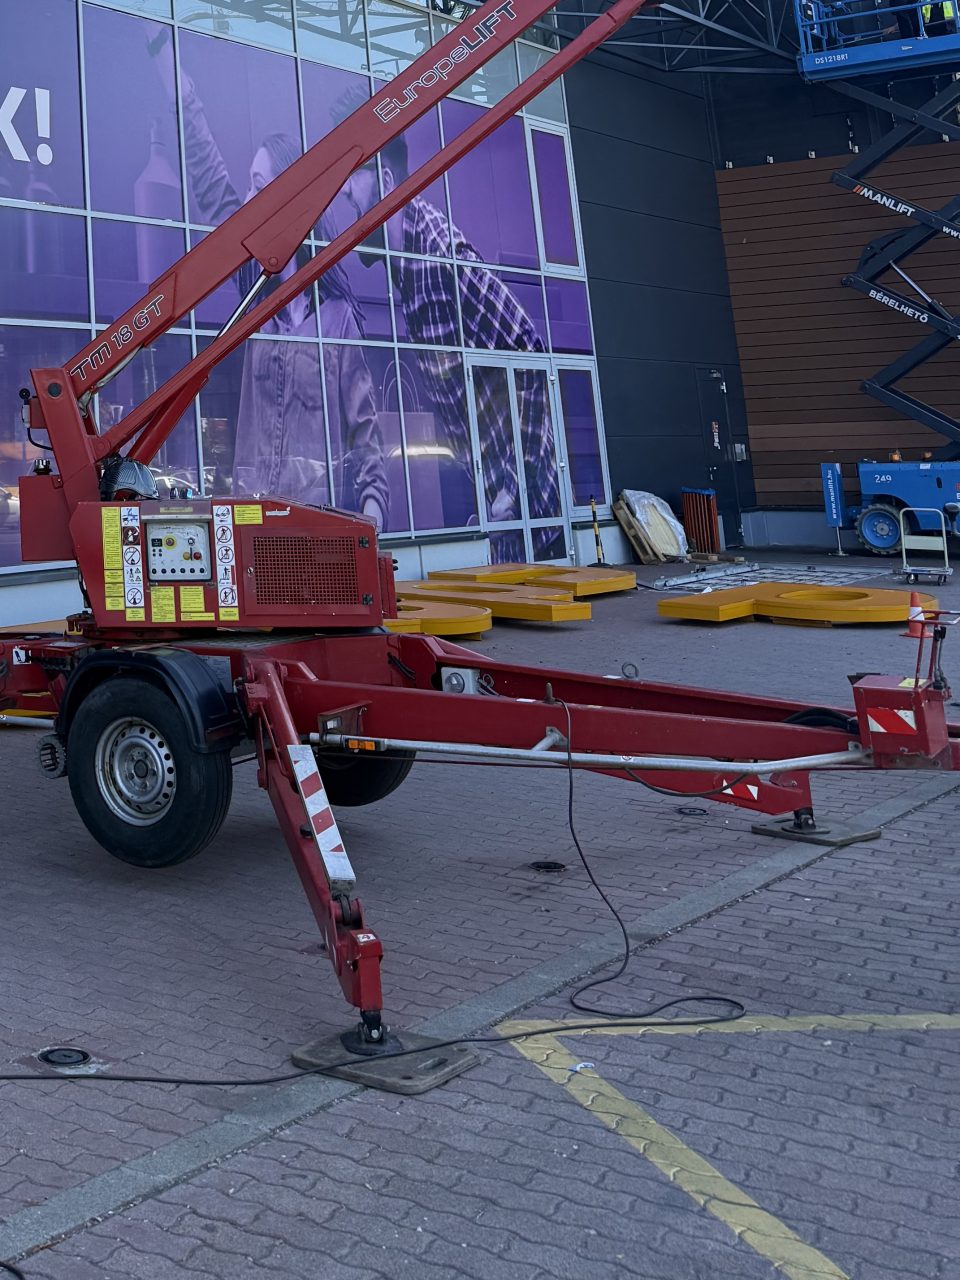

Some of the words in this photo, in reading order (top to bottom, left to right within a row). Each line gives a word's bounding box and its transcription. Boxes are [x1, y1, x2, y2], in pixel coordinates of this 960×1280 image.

[373, 0, 517, 123] EuropeLIFT
[70, 341, 111, 380] TM
[111, 324, 133, 349] 18
[133, 294, 164, 330] GT
[868, 289, 929, 323] BÉRELHETŐ
